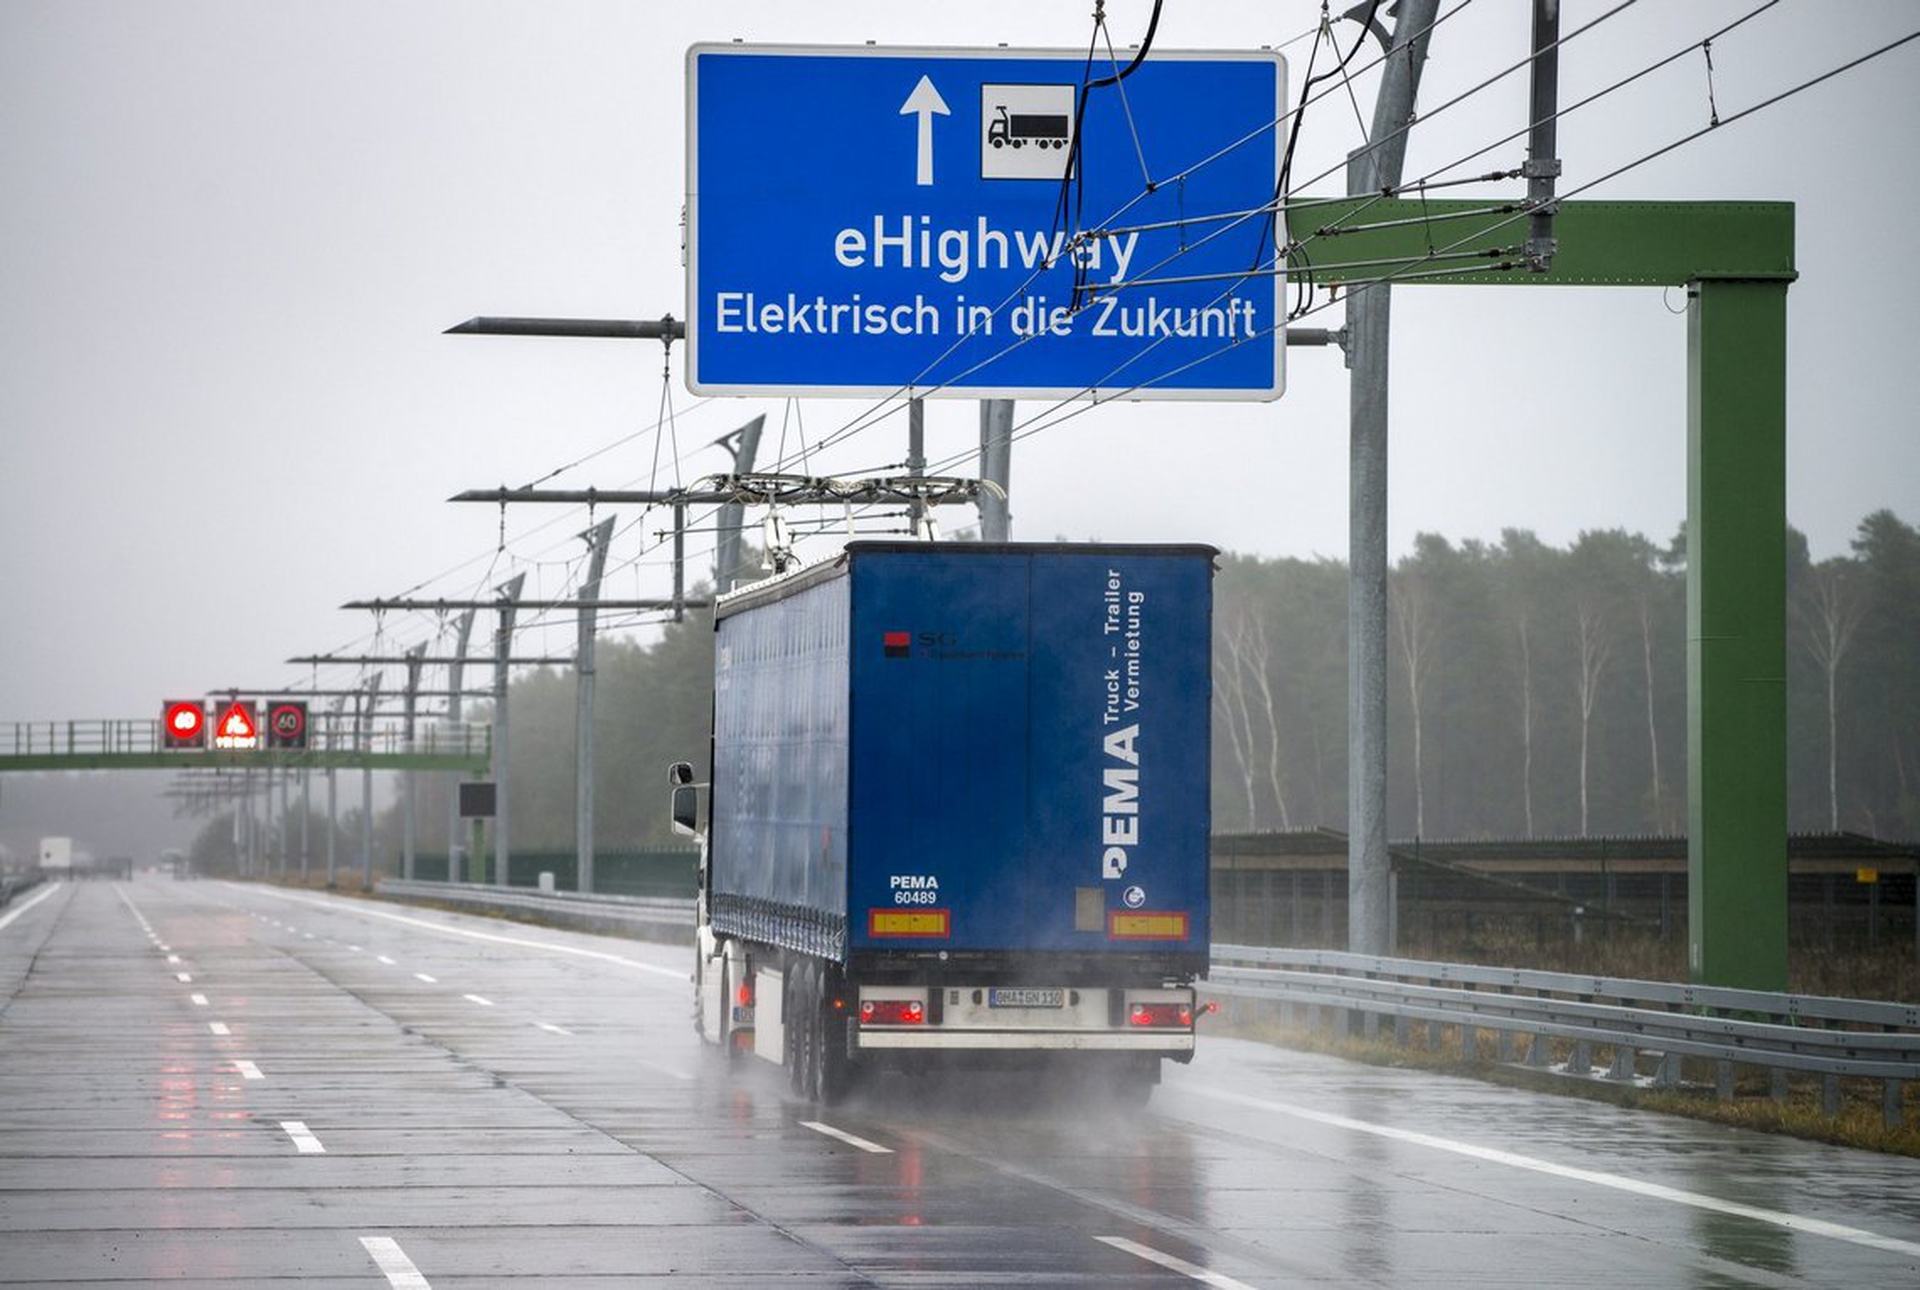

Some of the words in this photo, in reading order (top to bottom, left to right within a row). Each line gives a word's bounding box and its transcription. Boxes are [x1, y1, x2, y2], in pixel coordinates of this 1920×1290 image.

[835, 215, 1140, 283] eHighway
[717, 292, 939, 335] Elektrisch
[957, 295, 992, 335] in
[1011, 296, 1073, 336] die
[1092, 297, 1256, 337] Zukunft
[1103, 569, 1121, 635] Trailer
[1123, 591, 1145, 712] Vermietung
[278, 714, 296, 729] 60
[1103, 669, 1119, 725] Truck
[1102, 724, 1140, 879] PEMA
[890, 875, 939, 889] PEMA
[894, 891, 936, 904] 60489
